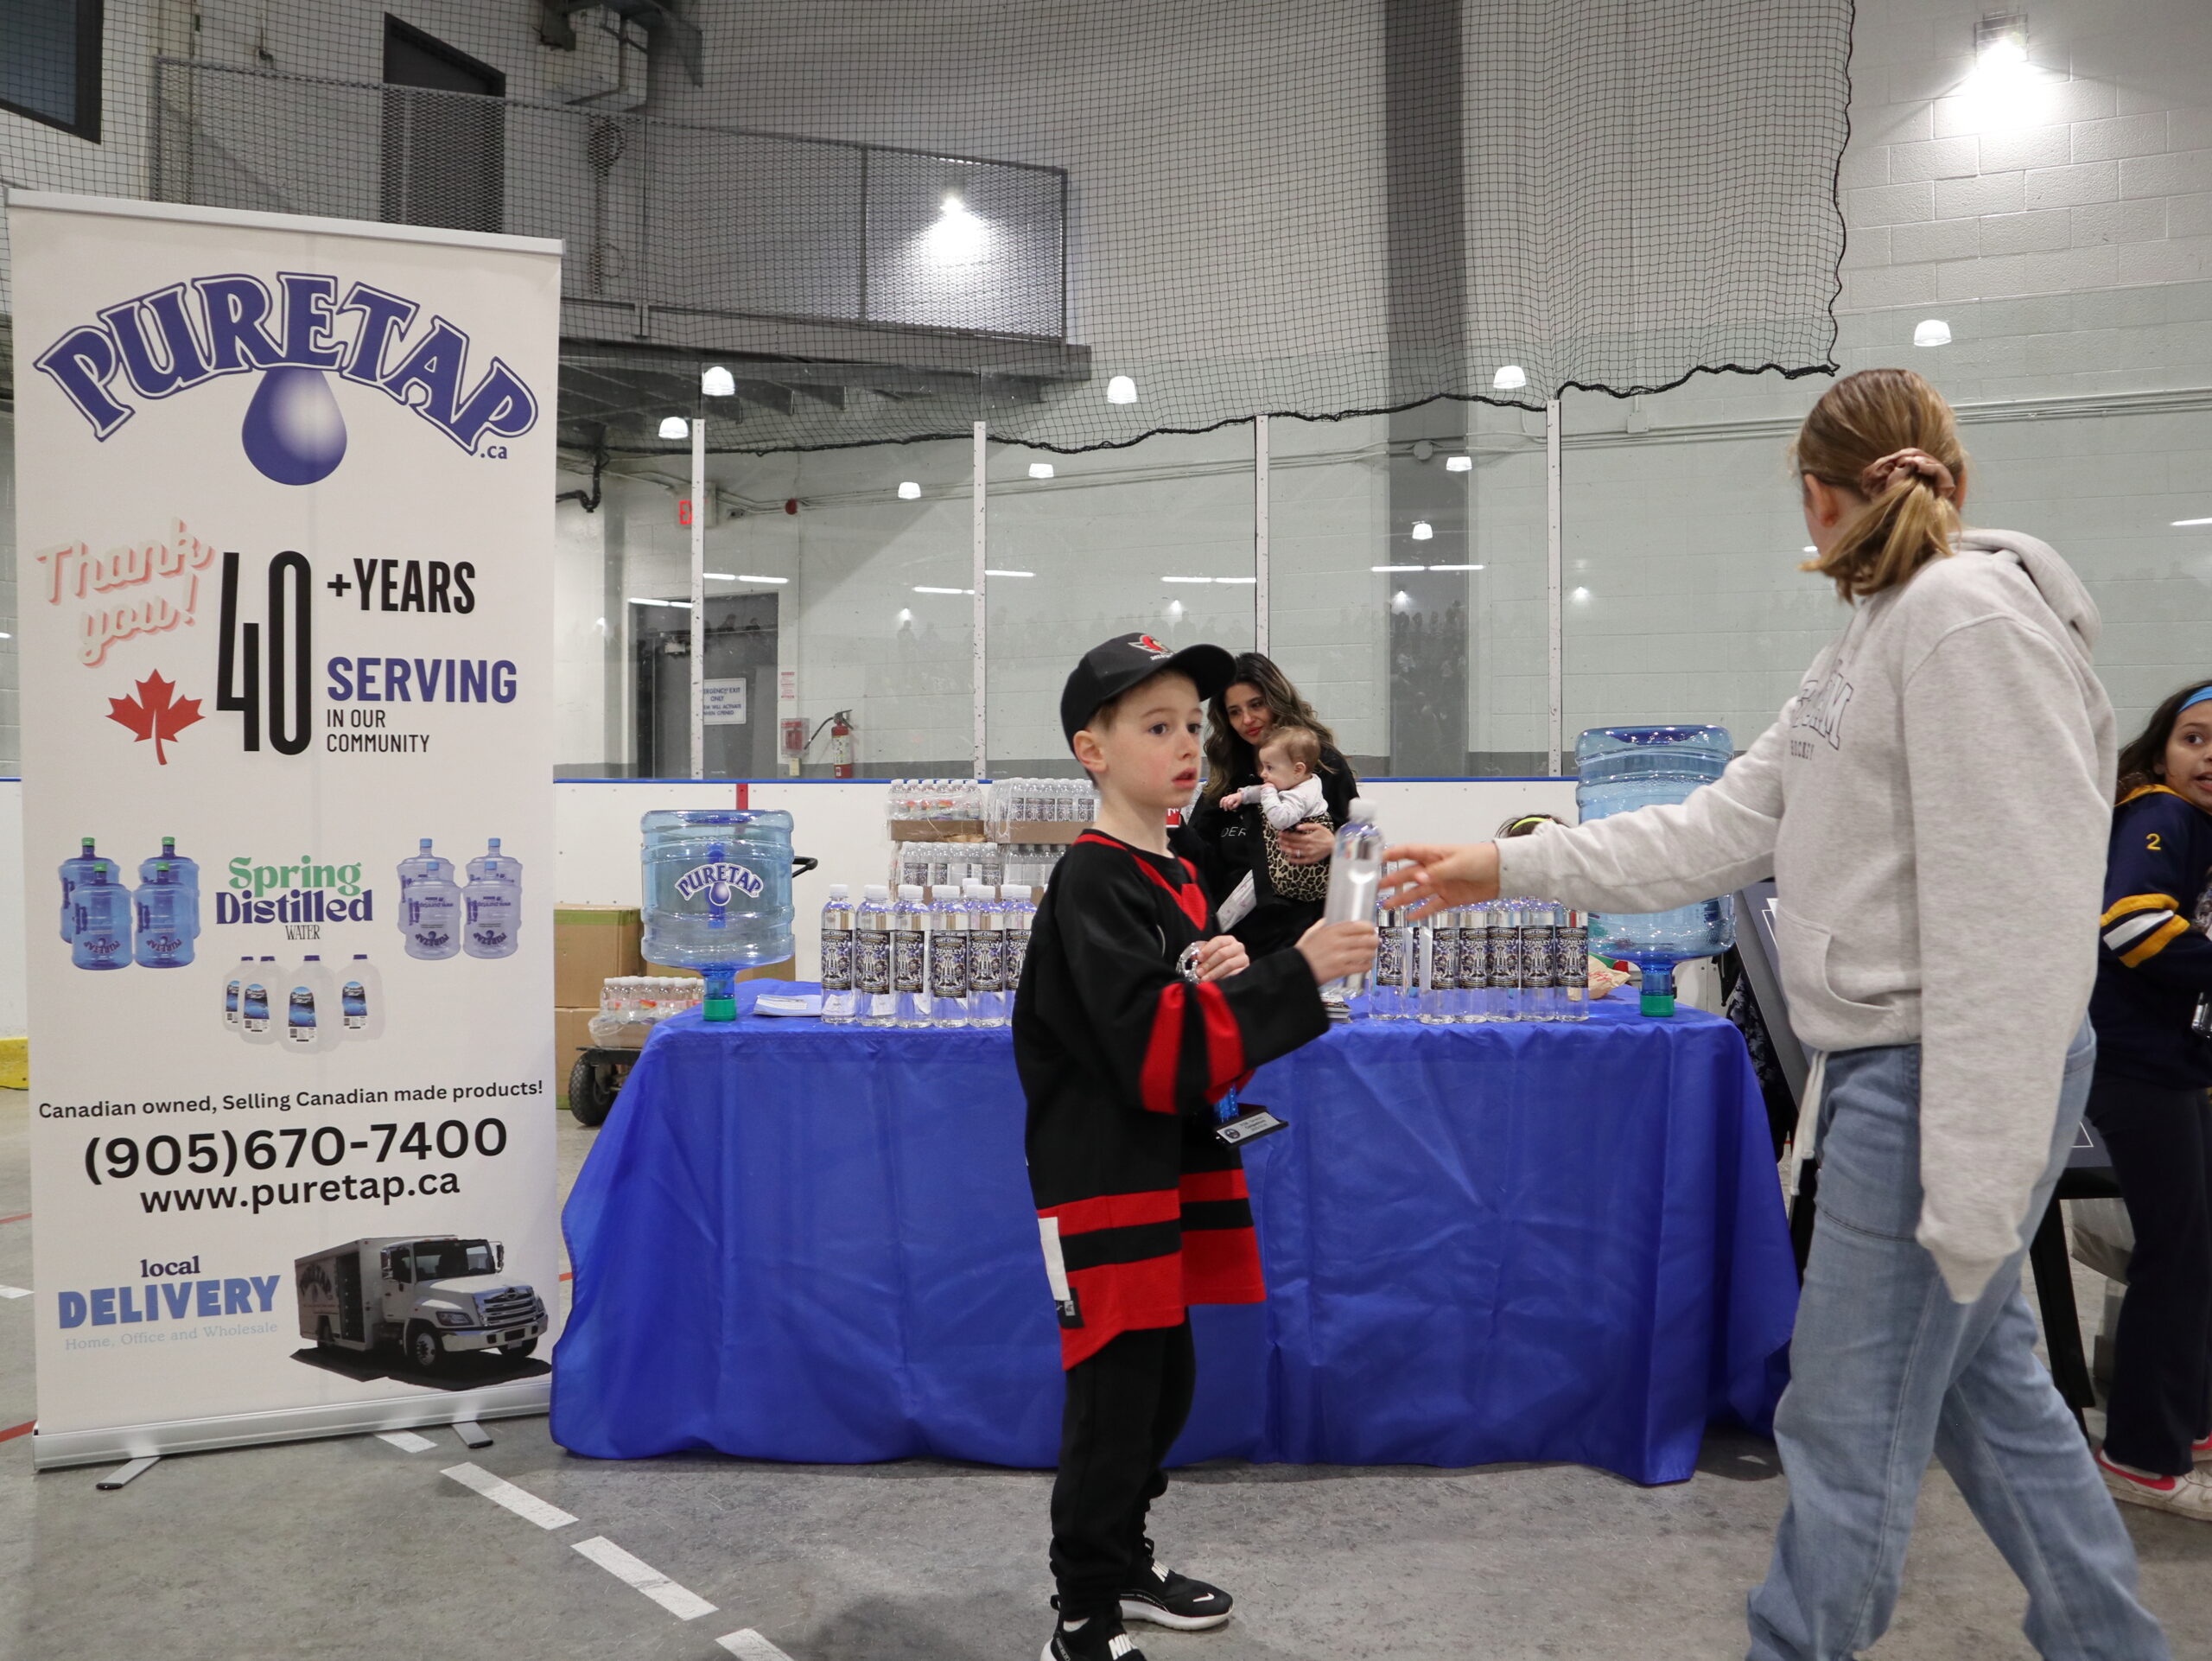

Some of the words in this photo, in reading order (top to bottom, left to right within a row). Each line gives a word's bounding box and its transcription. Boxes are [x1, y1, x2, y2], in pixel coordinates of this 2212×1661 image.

[33, 271, 539, 456] PURETAP
[480, 442, 508, 460] .ca
[36, 519, 214, 605] Thank
[327, 558, 475, 614] +YEARS
[80, 572, 199, 668] you!
[217, 551, 312, 755] 40
[327, 657, 517, 704] SERVING
[327, 710, 344, 728] IN
[351, 710, 385, 728] OUR
[327, 734, 430, 753] COMMUNITY
[2145, 833, 2161, 850] 2
[229, 856, 362, 897] Spring
[676, 864, 762, 898] PURETAP
[216, 888, 373, 925] Distilled
[285, 925, 321, 940] WATER
[39, 1100, 136, 1118] Canadian
[143, 1096, 218, 1115] owned,
[223, 1093, 291, 1111] Selling
[296, 1089, 388, 1107] Canadian
[395, 1085, 447, 1102] made
[453, 1080, 543, 1103] products!
[85, 1117, 507, 1186] (905)670-7400
[139, 1173, 461, 1214] www.puretap.ca
[140, 1255, 200, 1277] local
[58, 1275, 281, 1329] DELIVERY
[66, 1338, 115, 1351] Home,
[120, 1332, 165, 1346] Office
[172, 1328, 198, 1340] and
[202, 1321, 278, 1338] Wholesale
